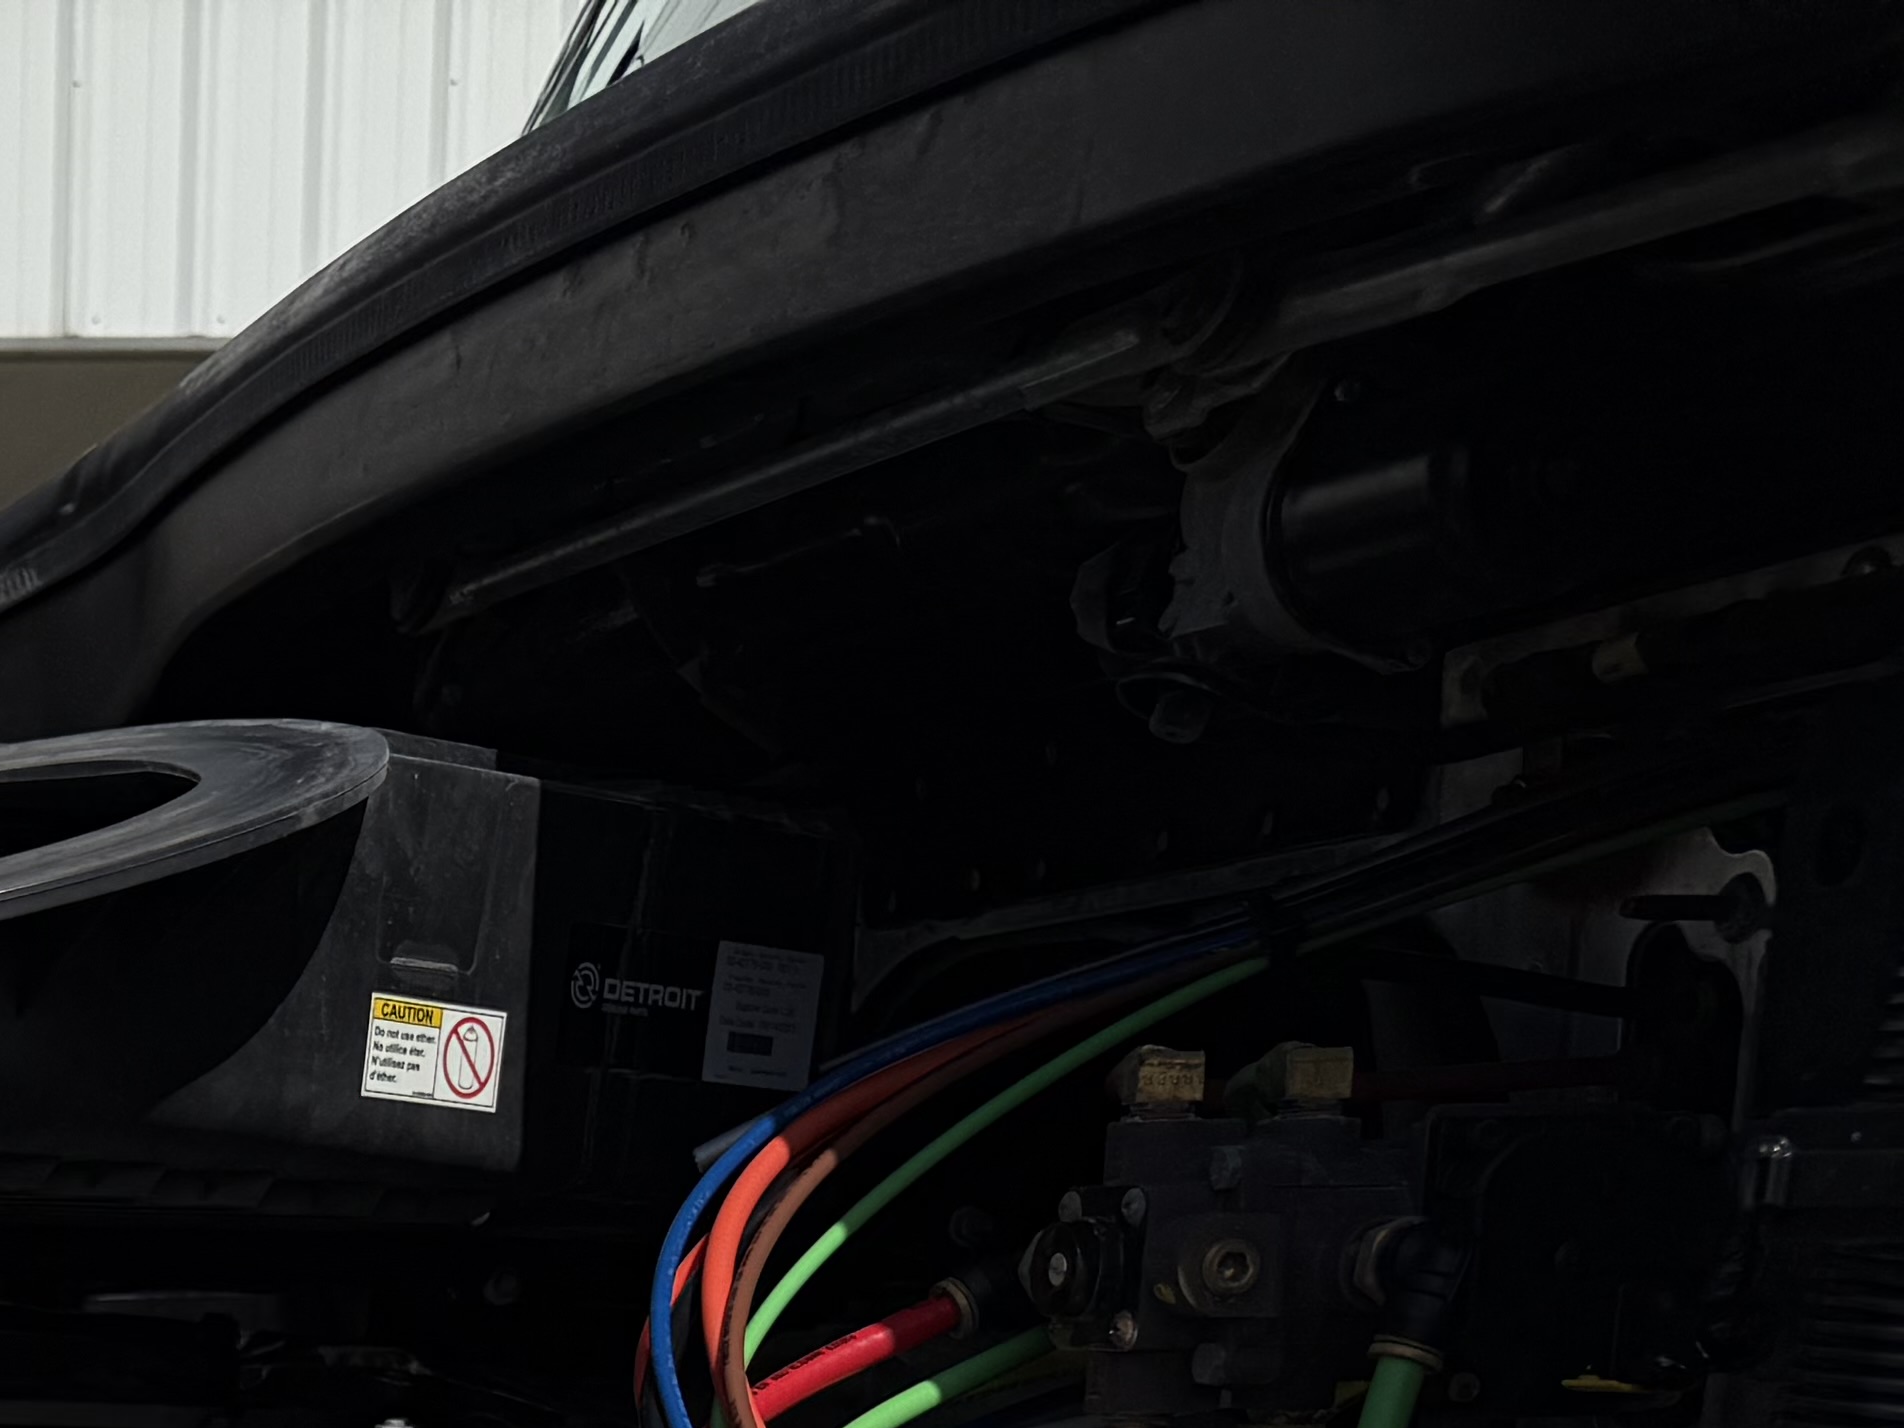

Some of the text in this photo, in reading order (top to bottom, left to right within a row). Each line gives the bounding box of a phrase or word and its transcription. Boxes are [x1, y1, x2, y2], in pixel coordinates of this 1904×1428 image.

[602, 977, 704, 1011] DETROIT
[380, 1002, 434, 1024] CAUTION
[374, 1025, 385, 1037] Do
[387, 1028, 400, 1038] not
[401, 1031, 414, 1041] use
